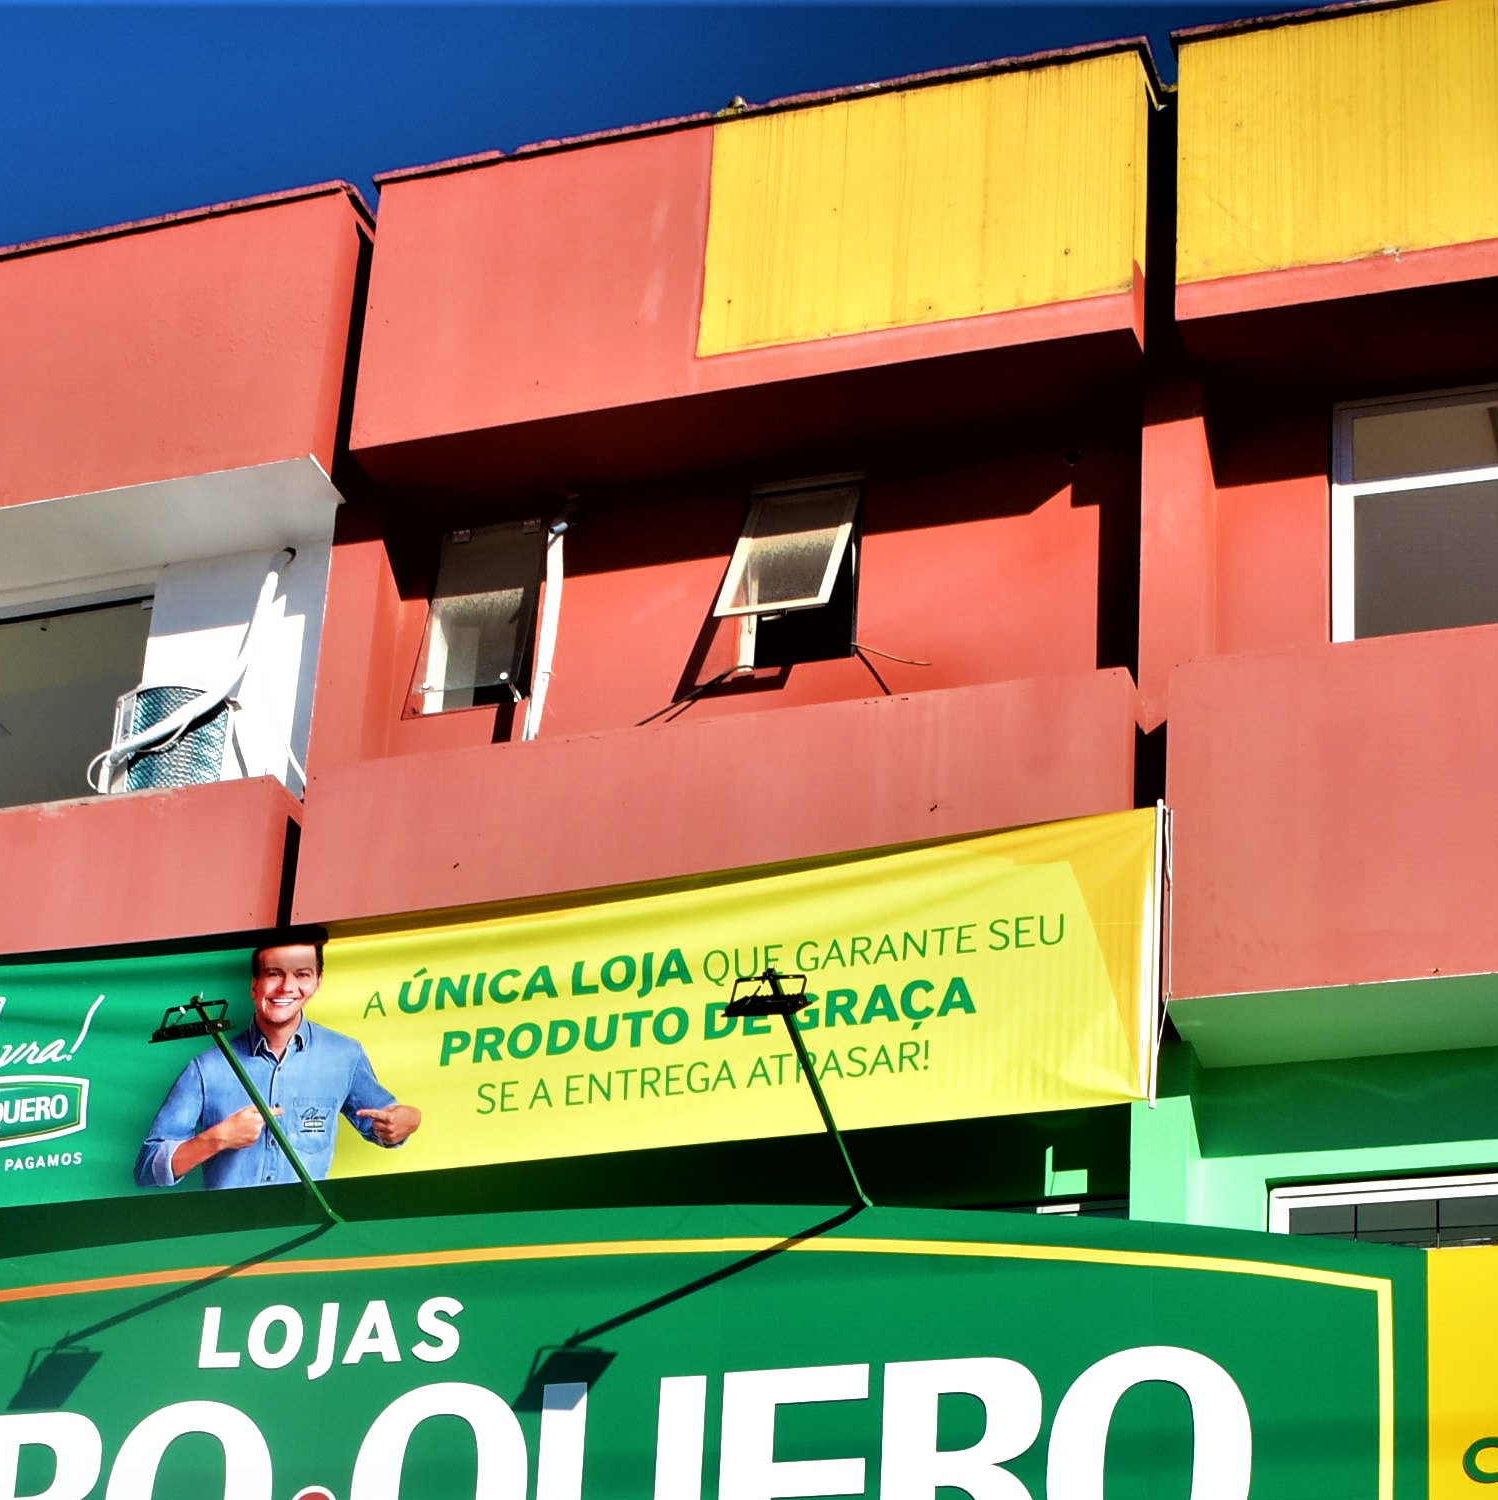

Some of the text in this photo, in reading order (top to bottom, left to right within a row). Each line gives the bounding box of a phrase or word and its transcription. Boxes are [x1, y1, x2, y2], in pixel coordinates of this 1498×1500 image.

[363, 913, 1065, 1019] A ÚNICA LOJA QUE GARANTE SEU
[439, 1006, 689, 1067] PRODUTO
[796, 977, 977, 1031] GRAÇA
[476, 1080, 519, 1115] SE
[528, 1079, 553, 1110] A
[565, 1060, 736, 1106] ENTREGA
[5, 1152, 83, 1171] PAGAMOS
[197, 1296, 464, 1380] LOJAS
